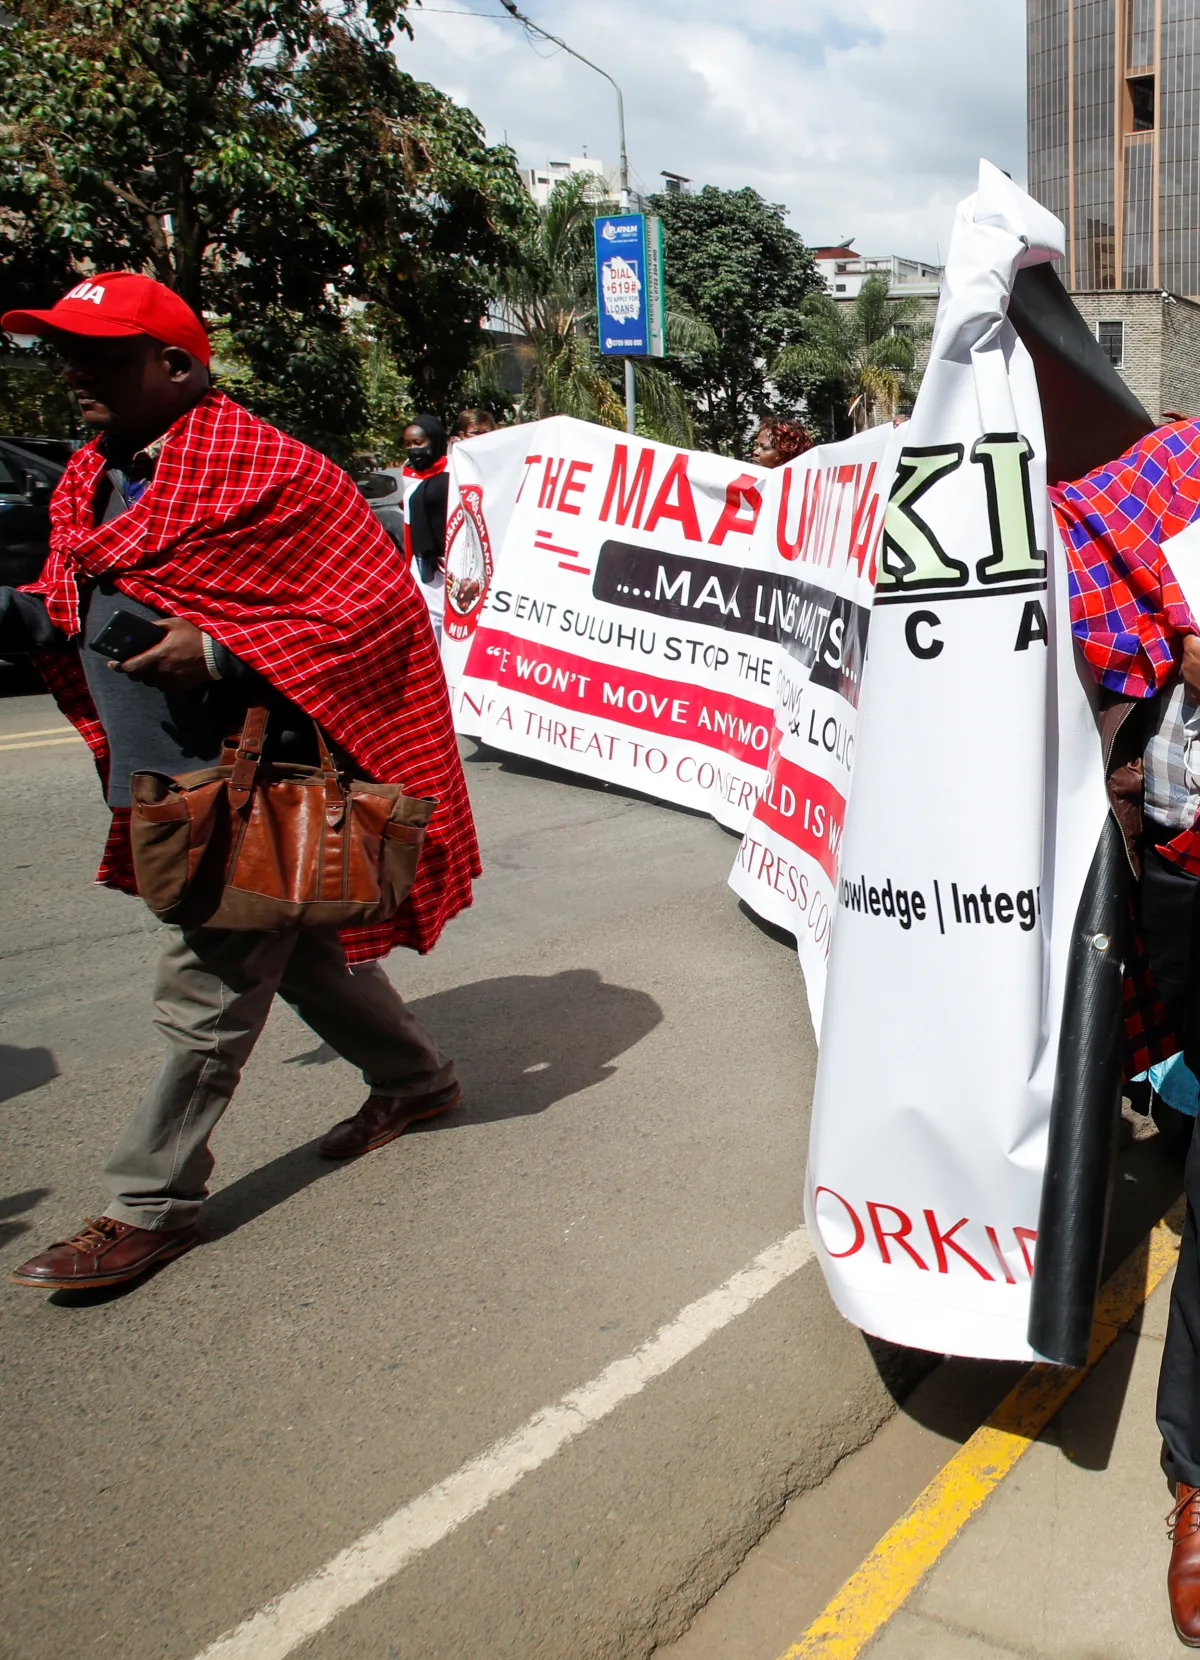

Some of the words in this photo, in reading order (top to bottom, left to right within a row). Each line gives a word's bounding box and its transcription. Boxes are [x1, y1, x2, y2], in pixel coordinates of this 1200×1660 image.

[609, 226, 638, 234] PLATINUM
[611, 269, 631, 279] DIAL
[611, 306, 634, 314] LOANS
[516, 455, 593, 516] THE
[448, 622, 468, 638] MUA
[560, 610, 656, 655] SULUHU
[663, 637, 729, 671] STOP
[737, 651, 773, 686] THE
[496, 705, 513, 730] A
[524, 709, 620, 761] THREAT
[628, 741, 668, 774] TO
[602, 682, 690, 724] MOVE
[803, 799, 826, 838] IS
